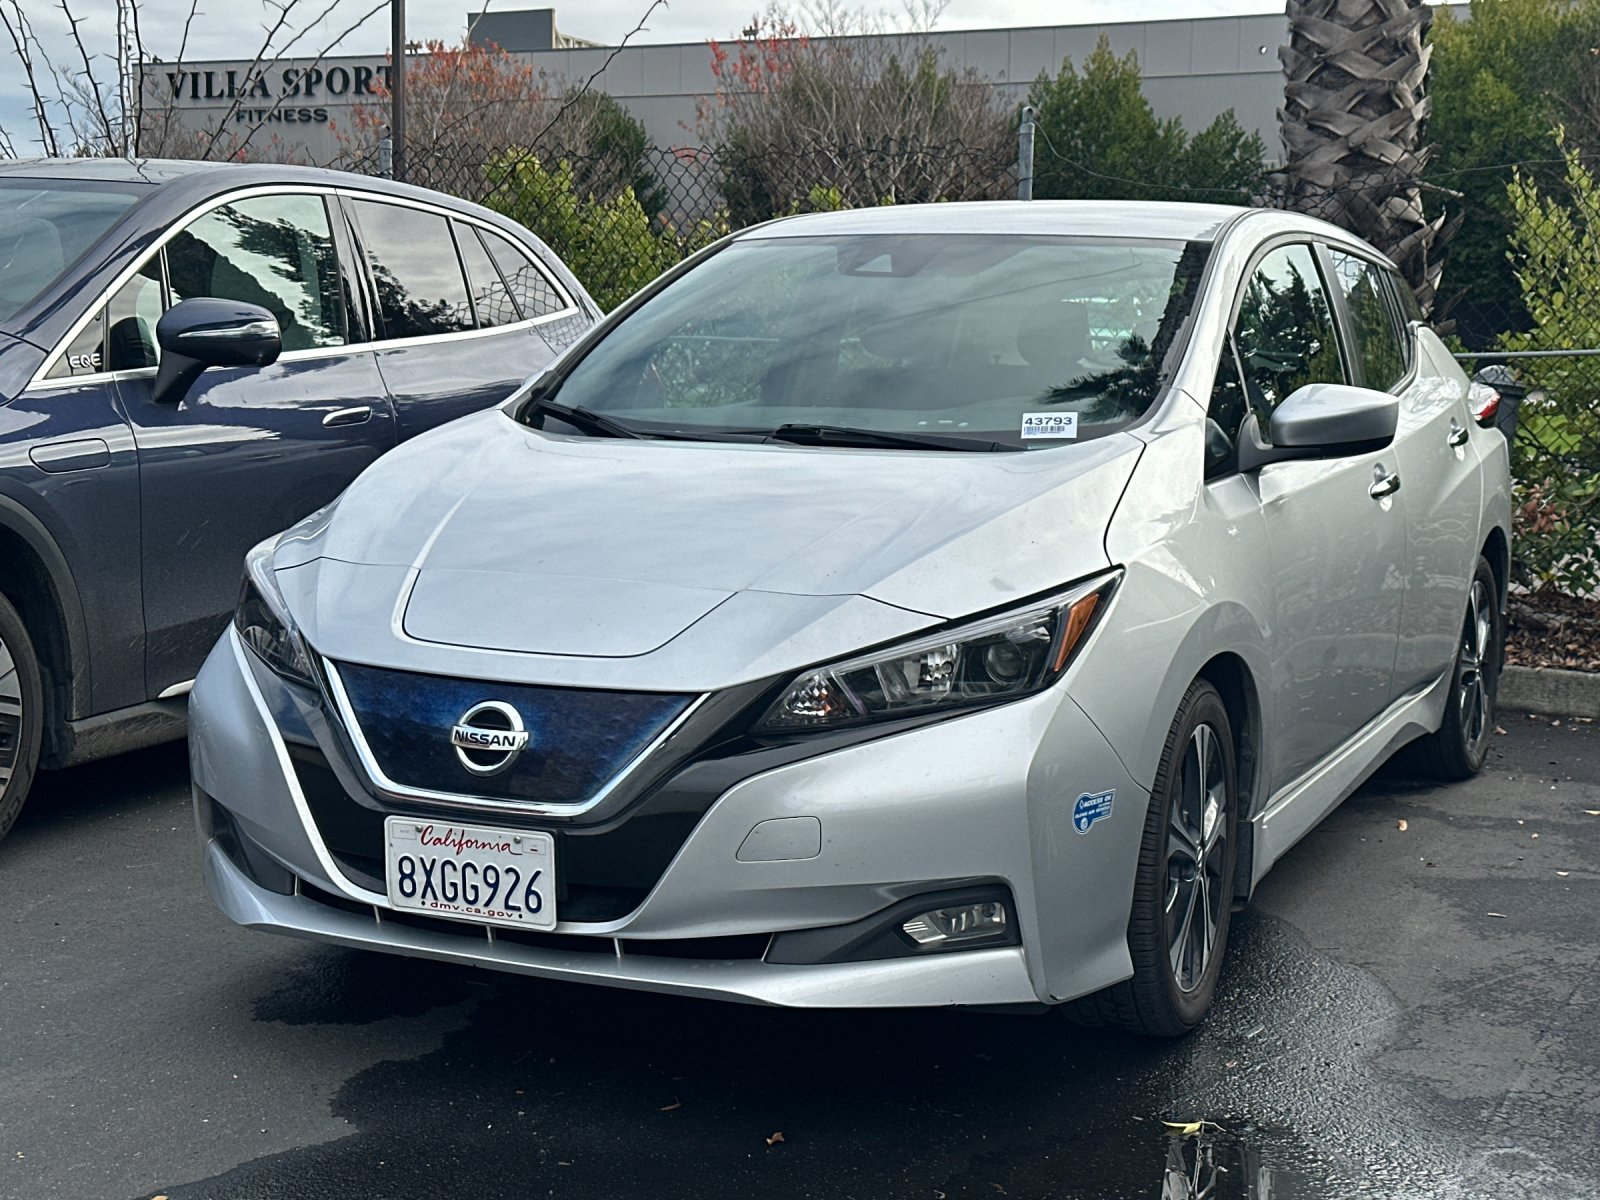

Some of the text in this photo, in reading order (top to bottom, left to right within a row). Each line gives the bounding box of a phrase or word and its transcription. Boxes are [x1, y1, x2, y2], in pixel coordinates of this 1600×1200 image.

[166, 69, 271, 100] VILLA
[235, 108, 329, 123] FITNESS
[70, 353, 102, 368] EQE
[1024, 416, 1073, 426] 43793
[453, 729, 516, 747] NISSAN
[420, 825, 523, 856] California
[398, 855, 543, 914] 8XGG926
[430, 901, 514, 918] dmv.ca.gov
